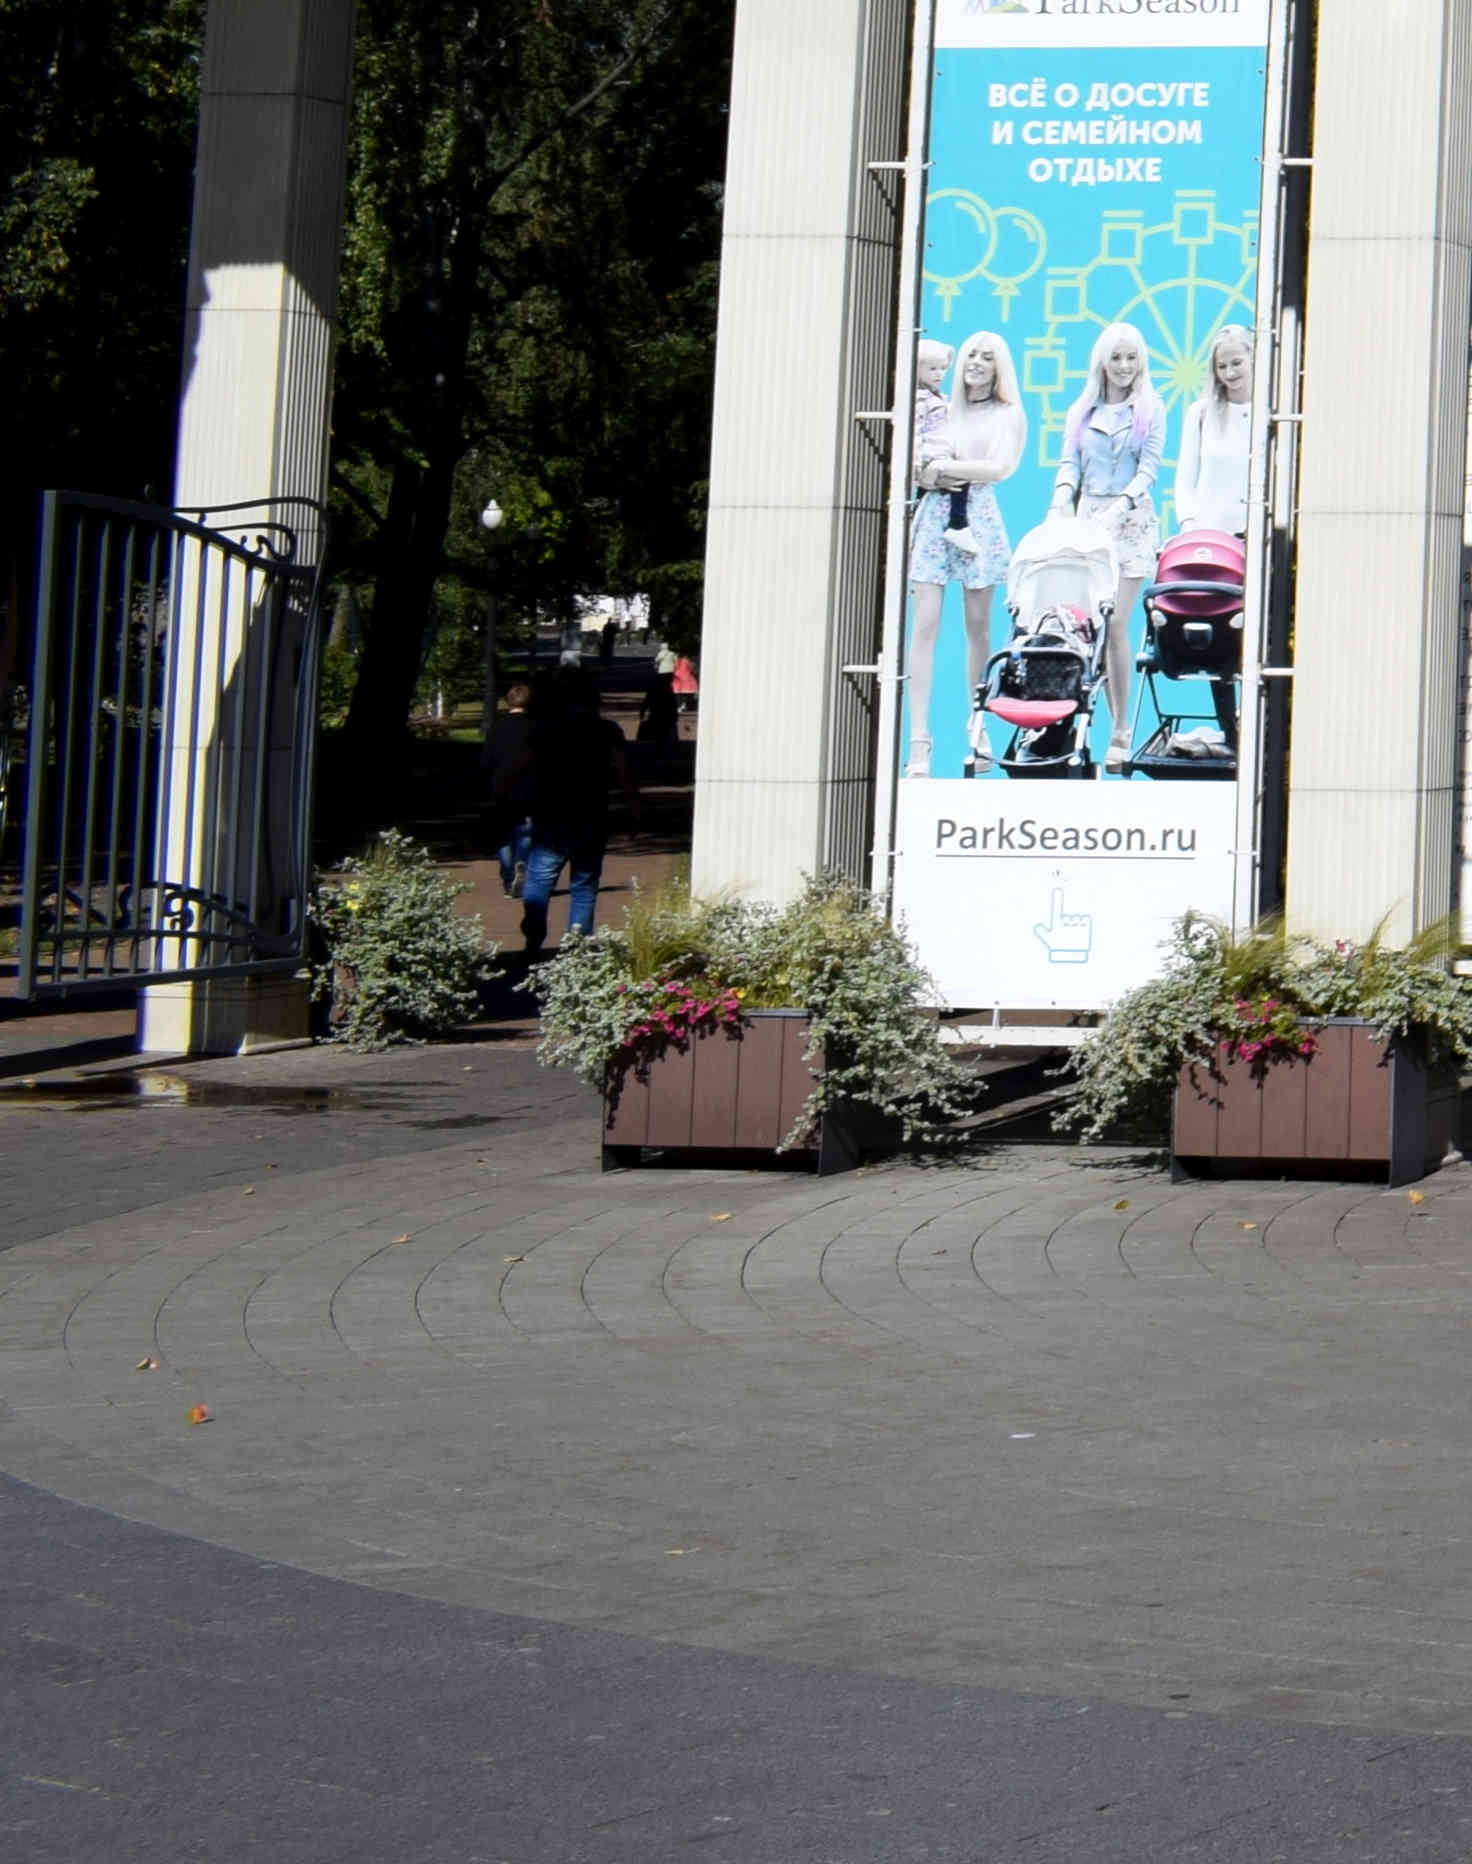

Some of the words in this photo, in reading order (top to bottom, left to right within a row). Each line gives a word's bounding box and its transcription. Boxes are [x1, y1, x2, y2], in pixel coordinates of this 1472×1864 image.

[988, 78, 1046, 109] ВСЁ
[1054, 82, 1080, 109] О
[1086, 82, 1211, 112] ДОСУГЕ
[992, 121, 1014, 146] И
[1021, 114, 1203, 146] СЕМЕЙНОМ
[1028, 156, 1163, 186] ОТДЫХЕ
[936, 817, 1198, 852] ParkSeason.ru
